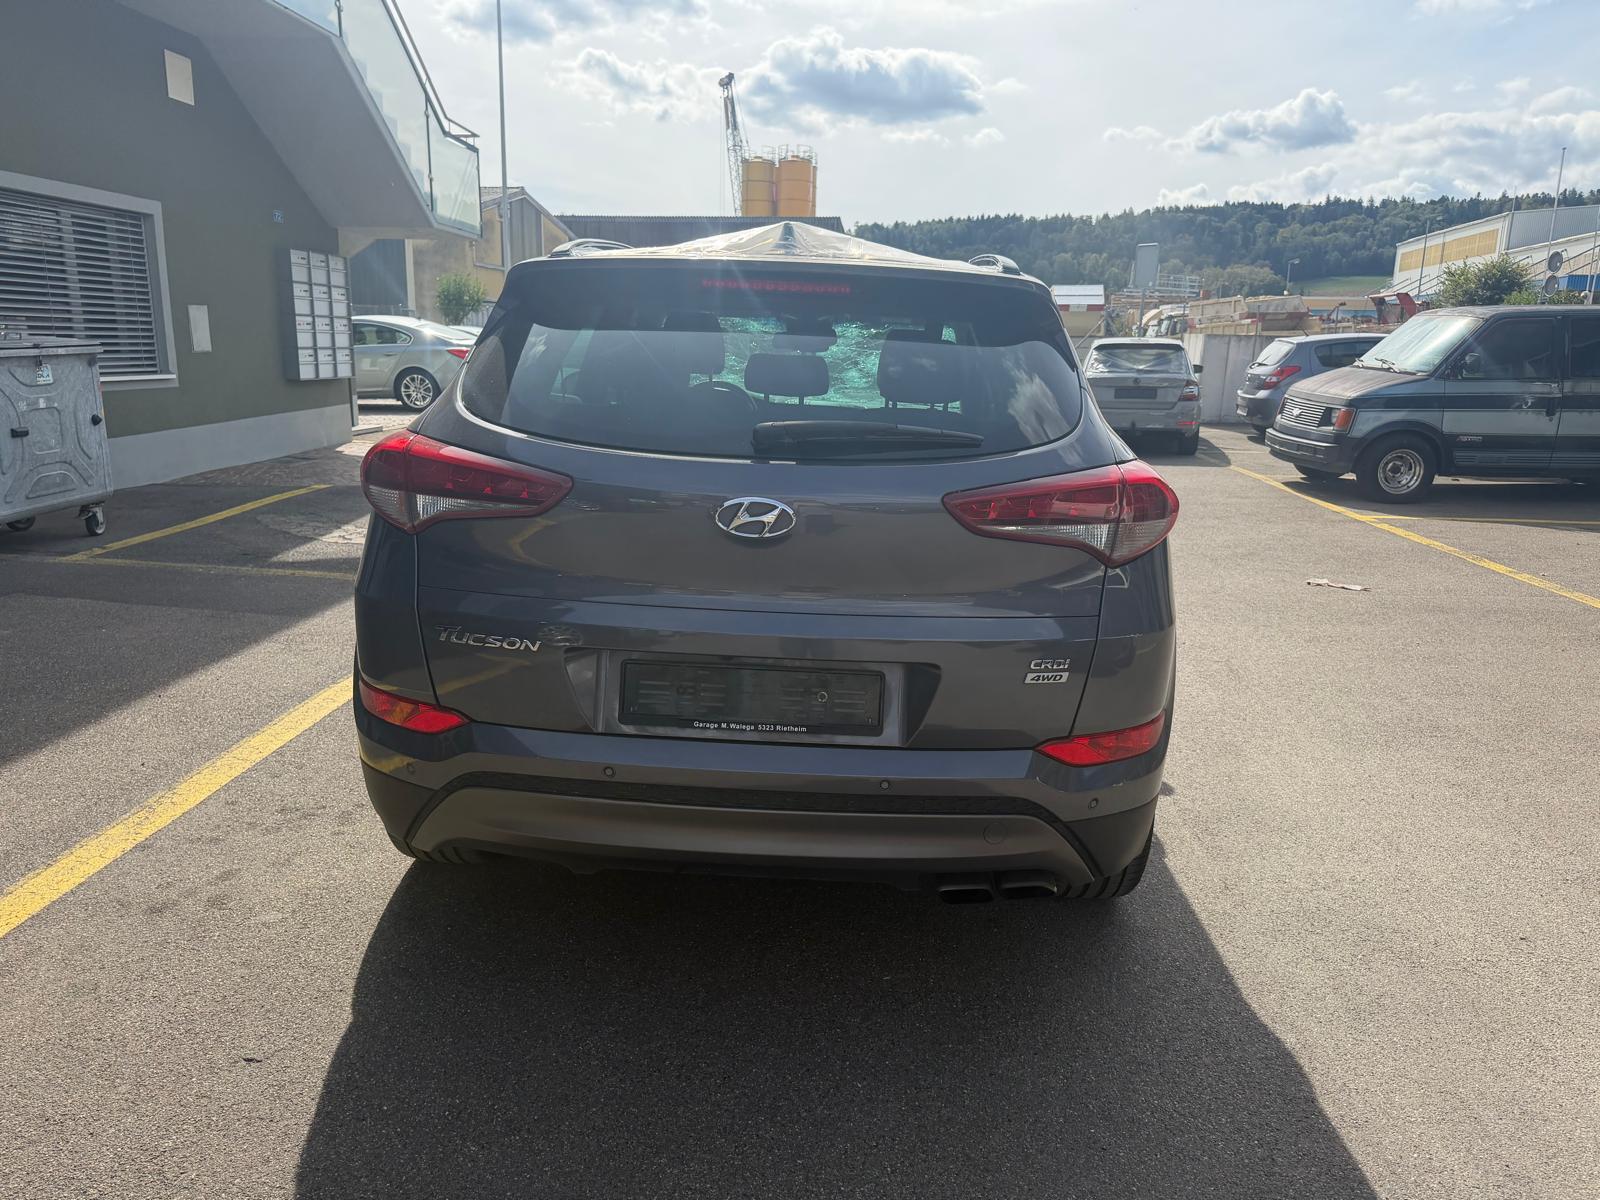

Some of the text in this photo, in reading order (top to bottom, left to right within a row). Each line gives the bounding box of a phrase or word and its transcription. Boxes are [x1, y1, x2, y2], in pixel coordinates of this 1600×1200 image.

[435, 625, 542, 652] TUCSON
[1030, 674, 1064, 682] 4WD
[693, 721, 719, 729] Garage
